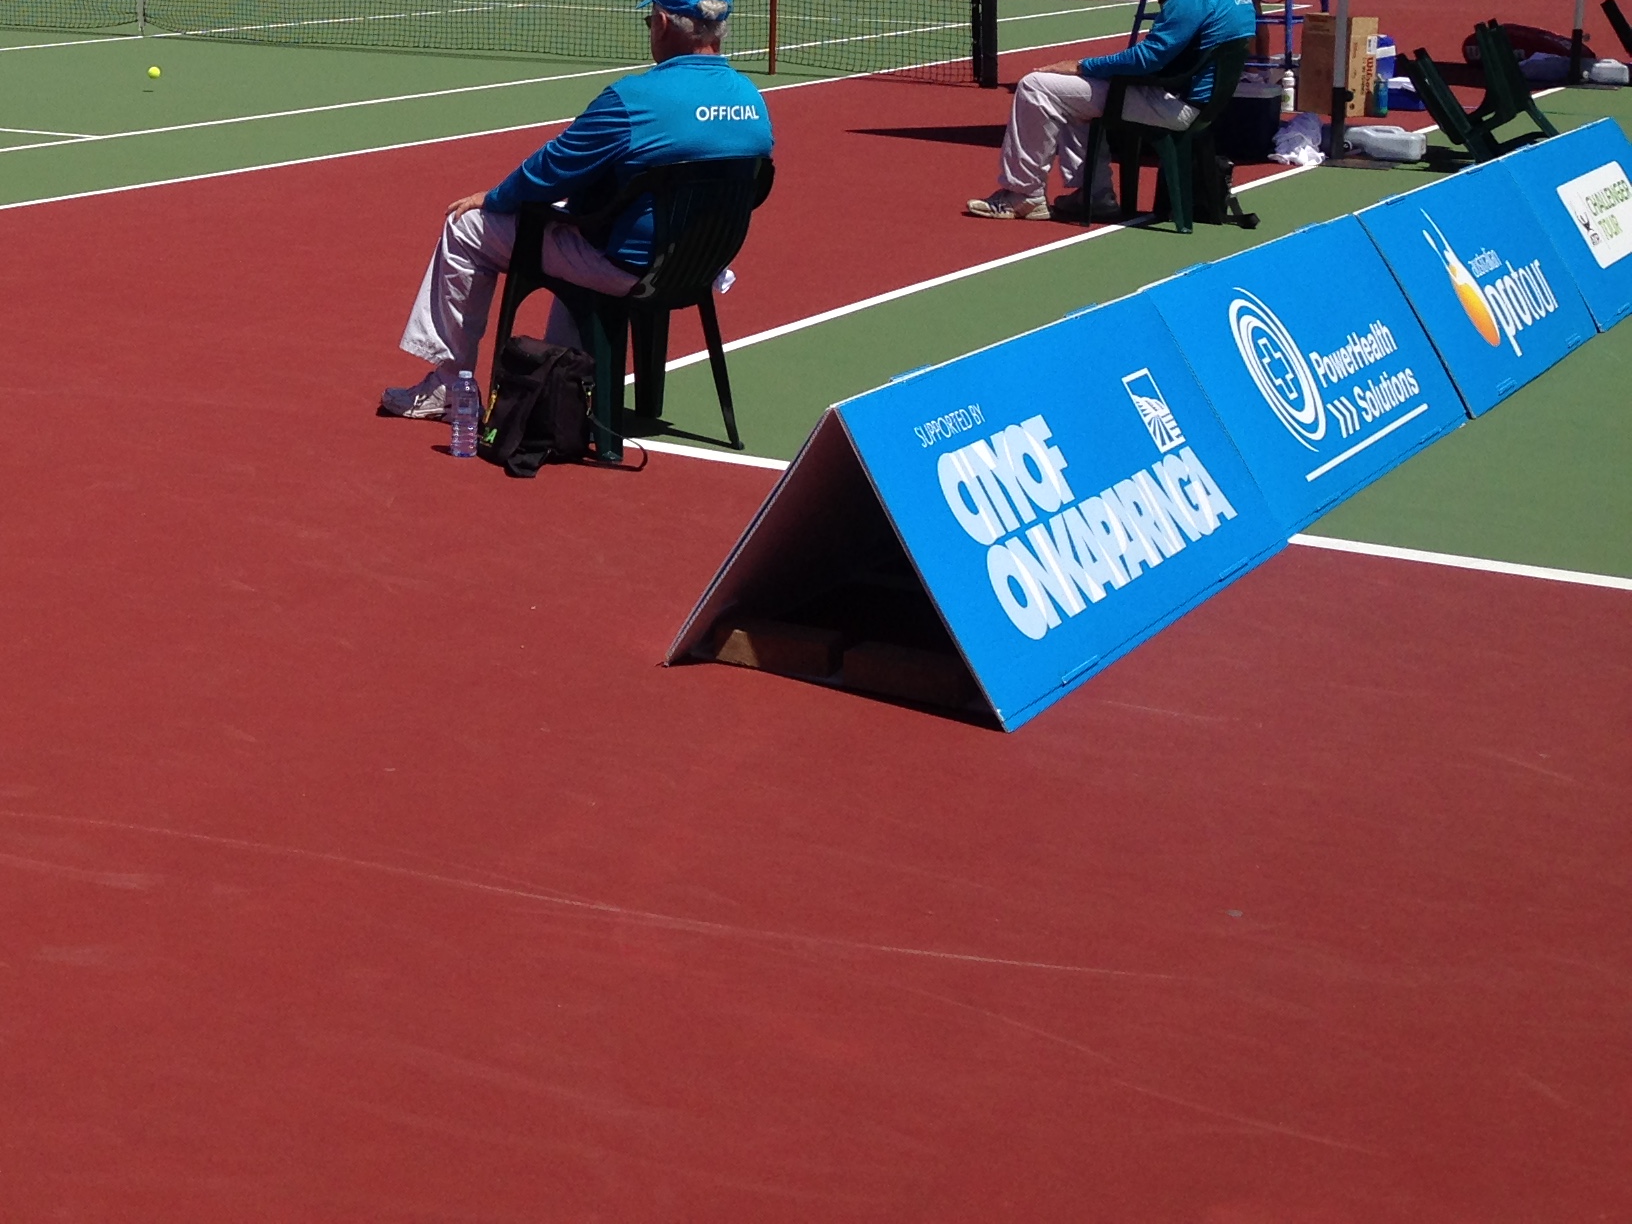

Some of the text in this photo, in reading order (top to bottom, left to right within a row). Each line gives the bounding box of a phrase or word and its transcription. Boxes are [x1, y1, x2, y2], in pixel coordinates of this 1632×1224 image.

[695, 105, 760, 121] OFFICIAL
[1484, 258, 1560, 357] protour
[1308, 319, 1399, 389] PowerHealth
[913, 403, 986, 449] SUPPORTED BY
[1352, 367, 1421, 423] Solutions
[986, 445, 1239, 641] ONKAPARINGA
